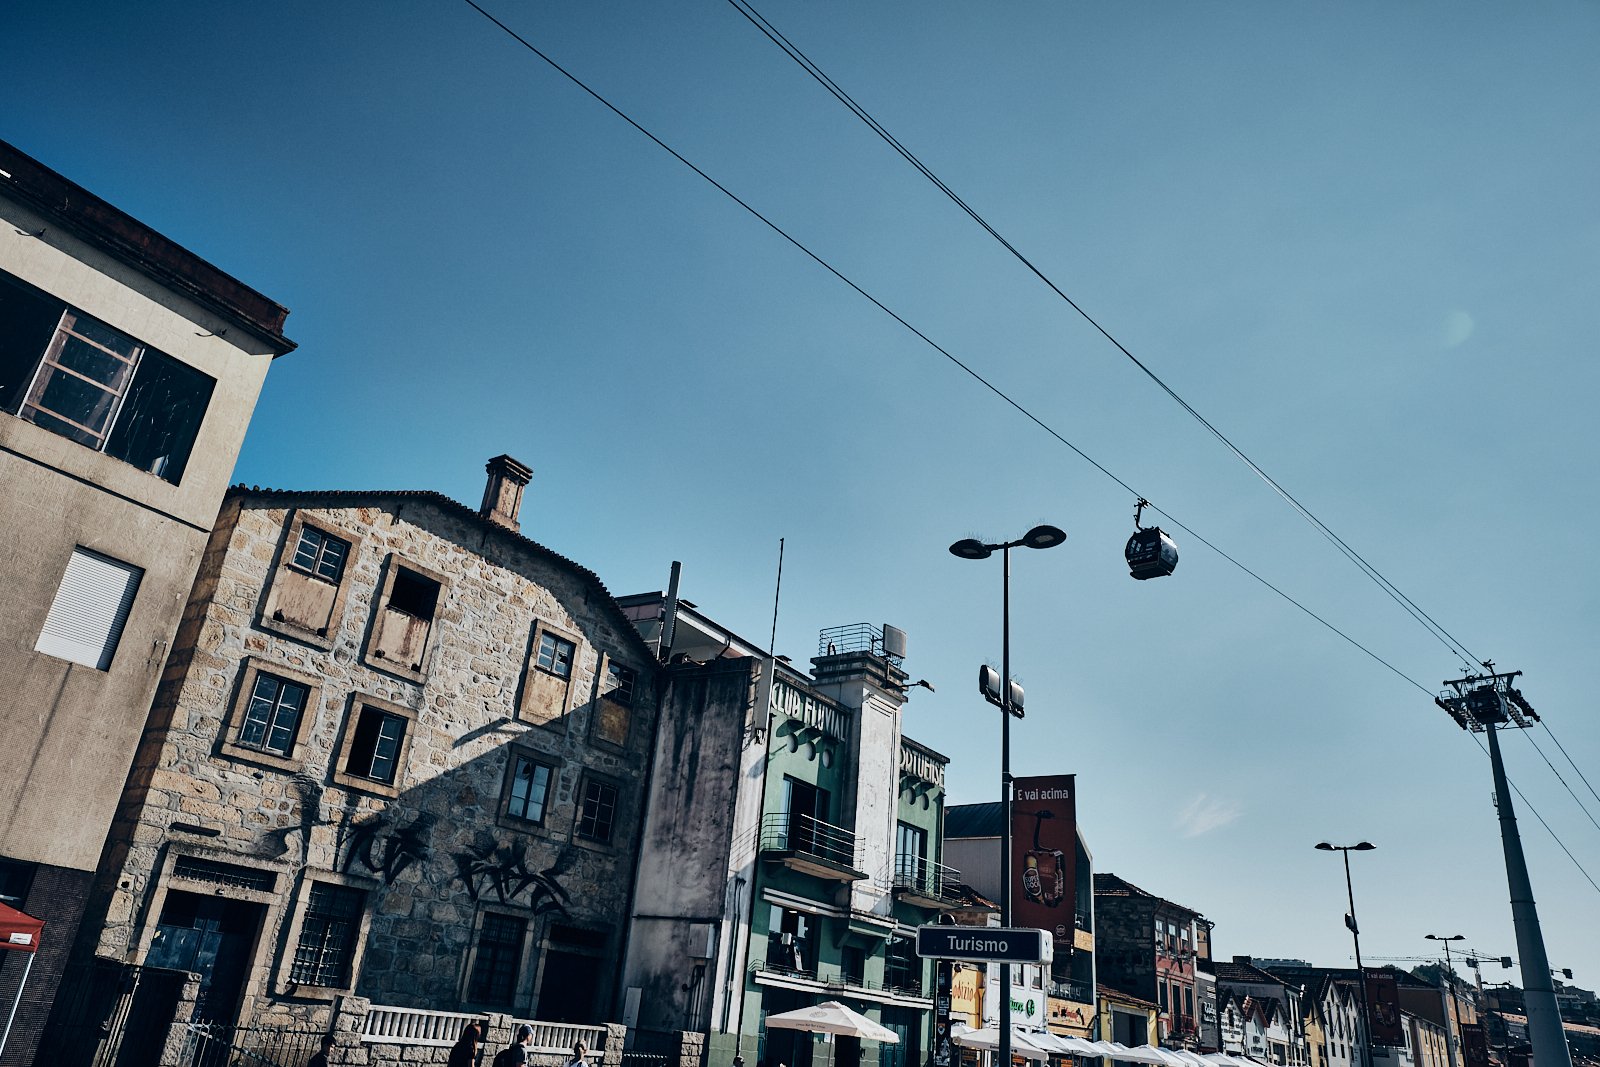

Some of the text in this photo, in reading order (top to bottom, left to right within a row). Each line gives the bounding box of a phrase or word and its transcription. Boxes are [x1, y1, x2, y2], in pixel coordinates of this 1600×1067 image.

[771, 682, 945, 788] CLUB FLUVIAL ORTUENSE
[1017, 787, 1069, 801] E vai acima
[947, 935, 1009, 954] Turismo
